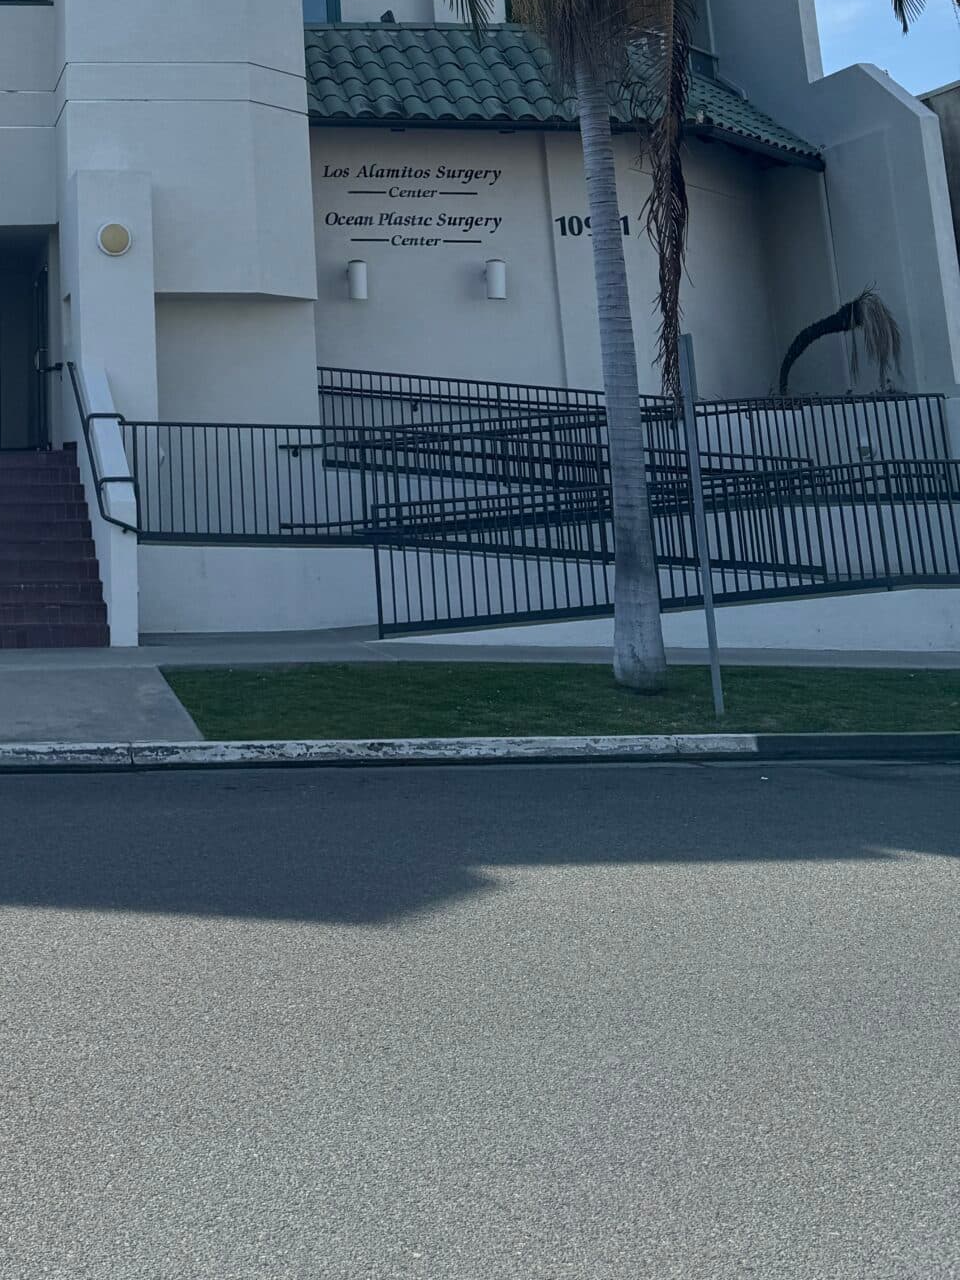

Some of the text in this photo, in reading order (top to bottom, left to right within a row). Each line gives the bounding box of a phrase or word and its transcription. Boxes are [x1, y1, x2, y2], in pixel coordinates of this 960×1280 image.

[323, 163, 502, 186] Los Alamitos Surgery
[388, 185, 438, 199] Center
[324, 211, 502, 234] Ocean Plastic Surgery
[554, 215, 630, 236] 101
[390, 234, 442, 248] Center
